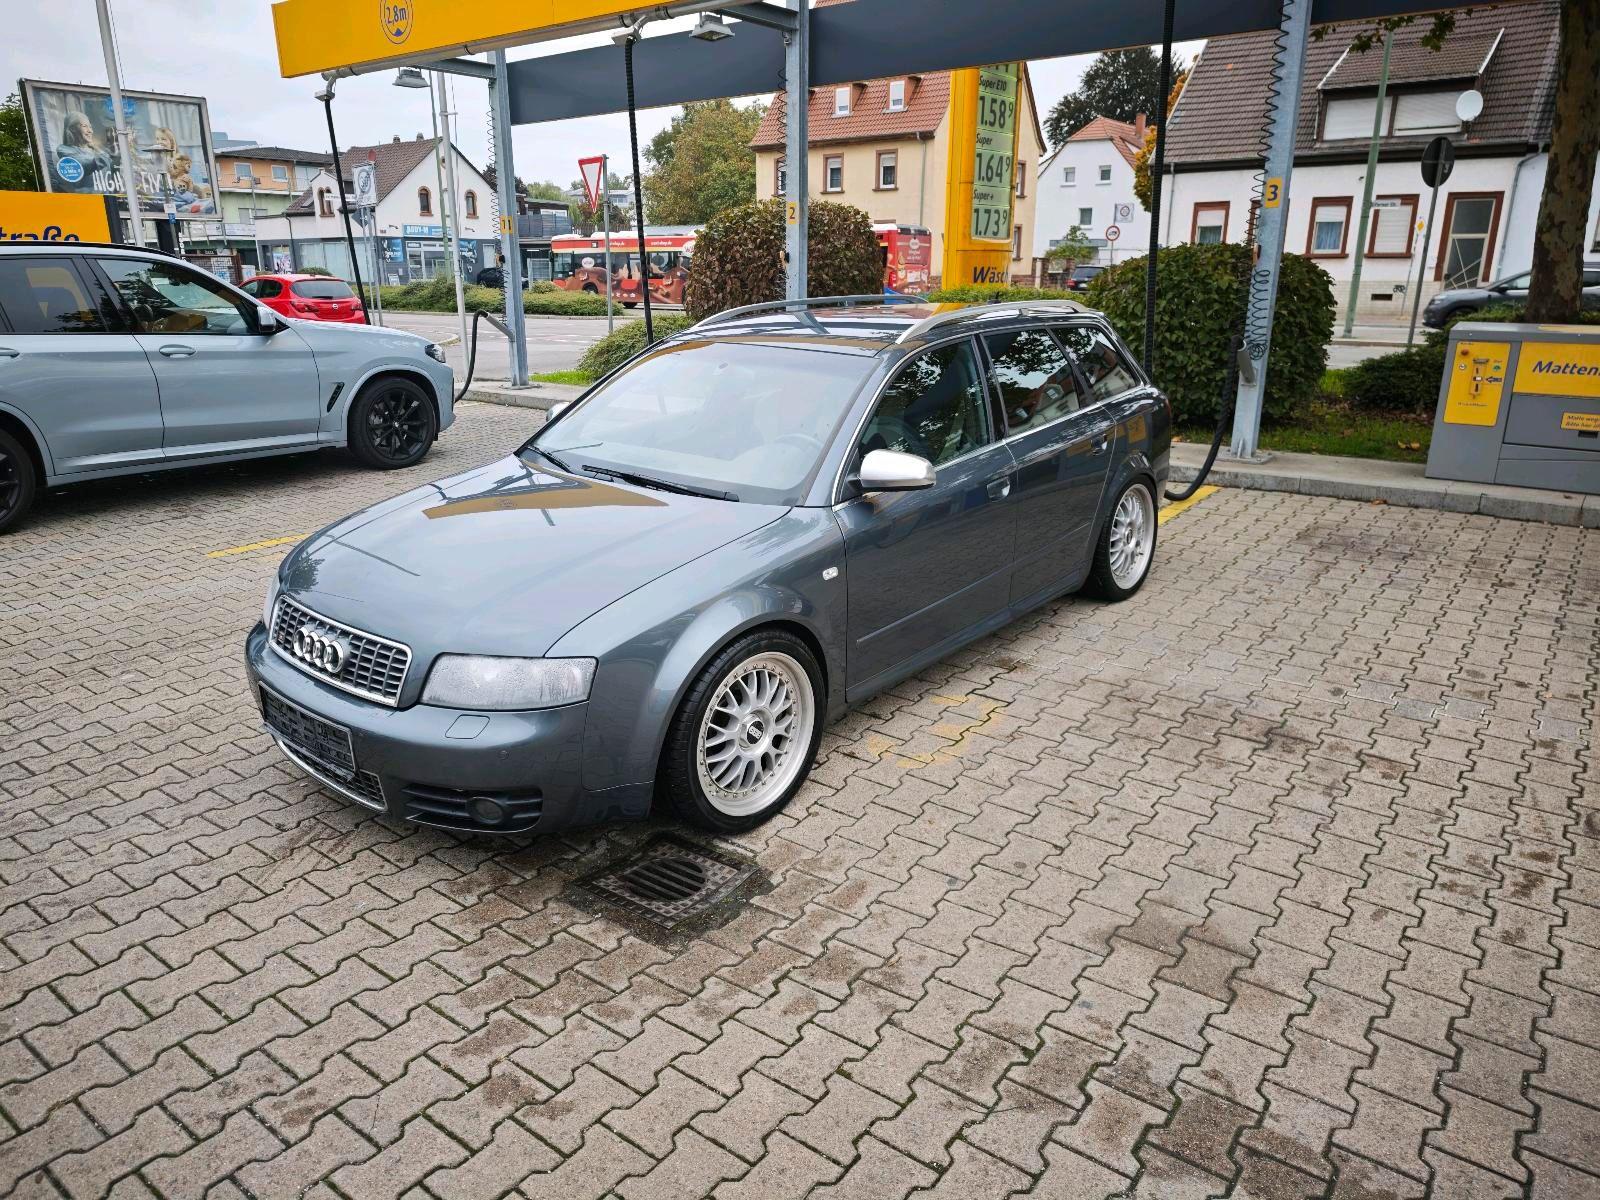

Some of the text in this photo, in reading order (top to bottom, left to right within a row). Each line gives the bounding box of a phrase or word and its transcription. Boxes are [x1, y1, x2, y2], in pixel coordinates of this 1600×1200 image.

[386, 4, 407, 26] 2,8m
[979, 75, 1007, 92] Super E10
[976, 133, 993, 148] Super
[92, 170, 174, 195] HIGH FIV!
[973, 189, 994, 203] Super+
[1267, 184, 1279, 202] 3
[789, 206, 796, 220] 2
[1532, 360, 1600, 376] Matten
